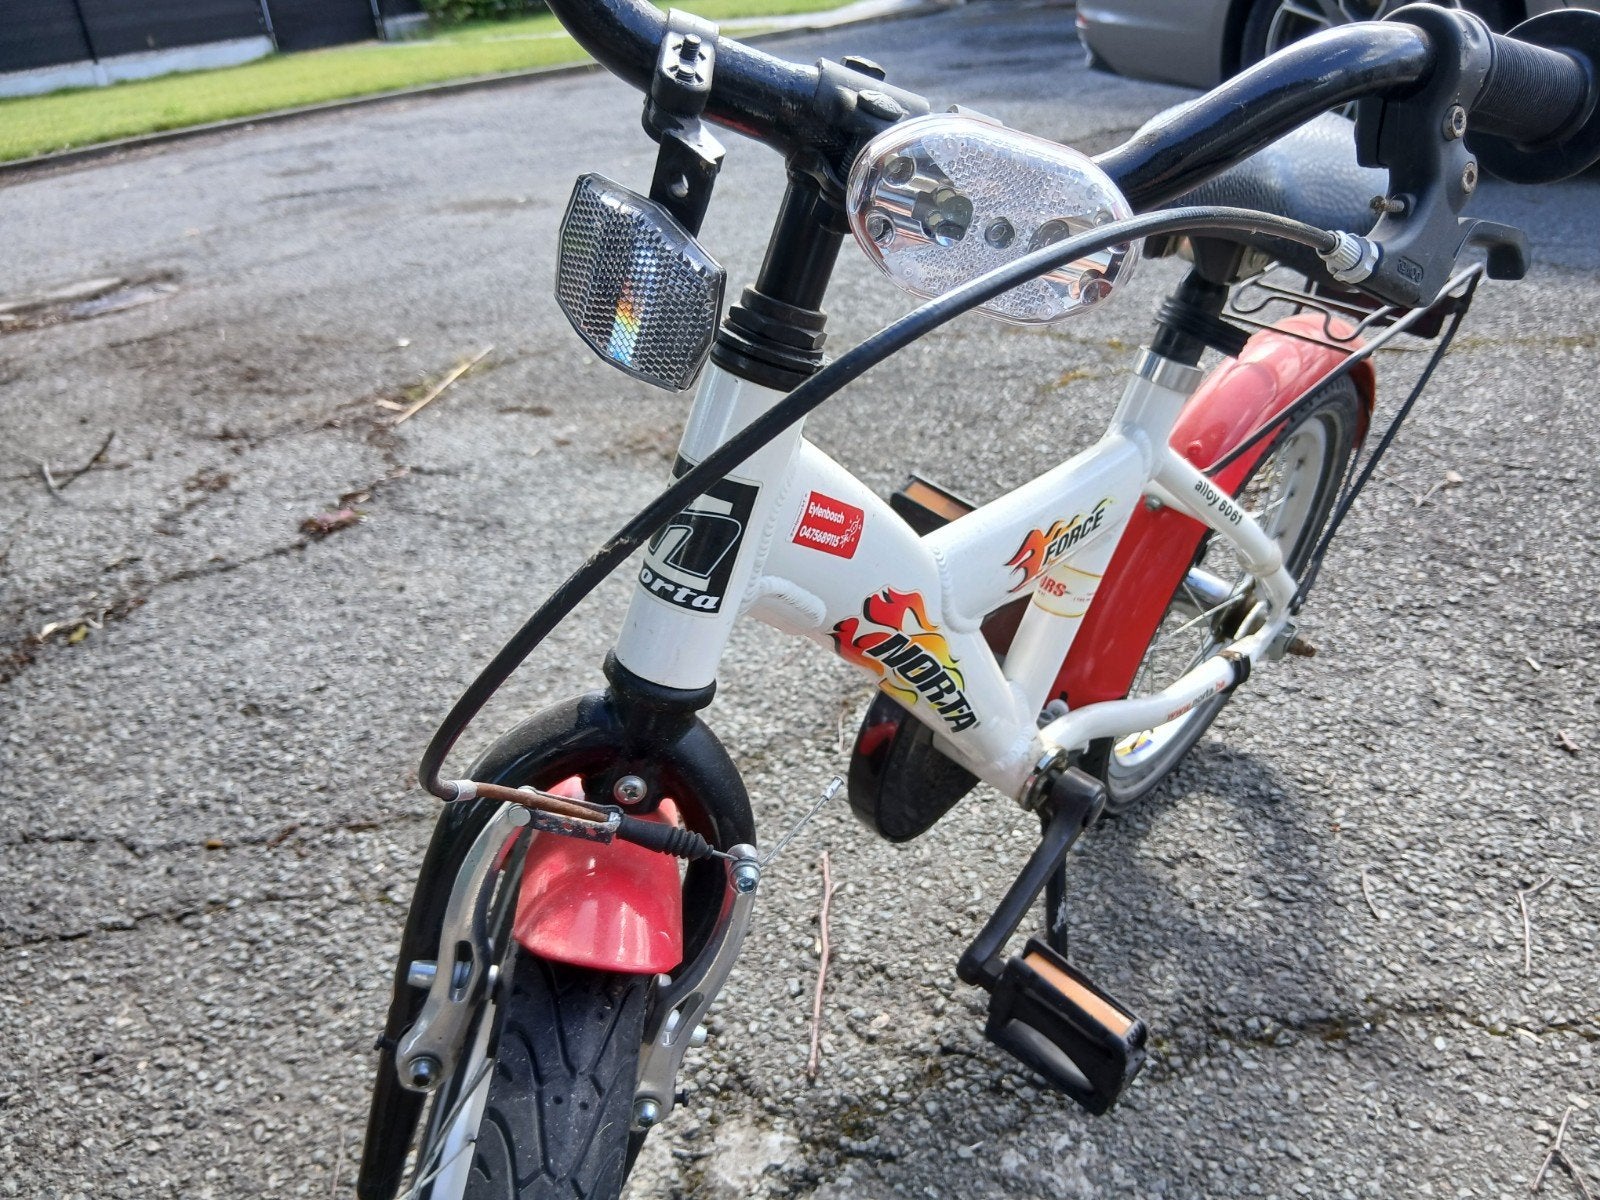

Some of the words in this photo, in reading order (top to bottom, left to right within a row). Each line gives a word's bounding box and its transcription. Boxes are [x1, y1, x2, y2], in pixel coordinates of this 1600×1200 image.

[808, 501, 845, 525] Eylenbosch
[1195, 480, 1220, 506] alloy
[1219, 500, 1243, 525] 6061
[799, 525, 841, 548] 0475689115
[1042, 507, 1105, 566] FORCE
[864, 632, 978, 733] NORTA
